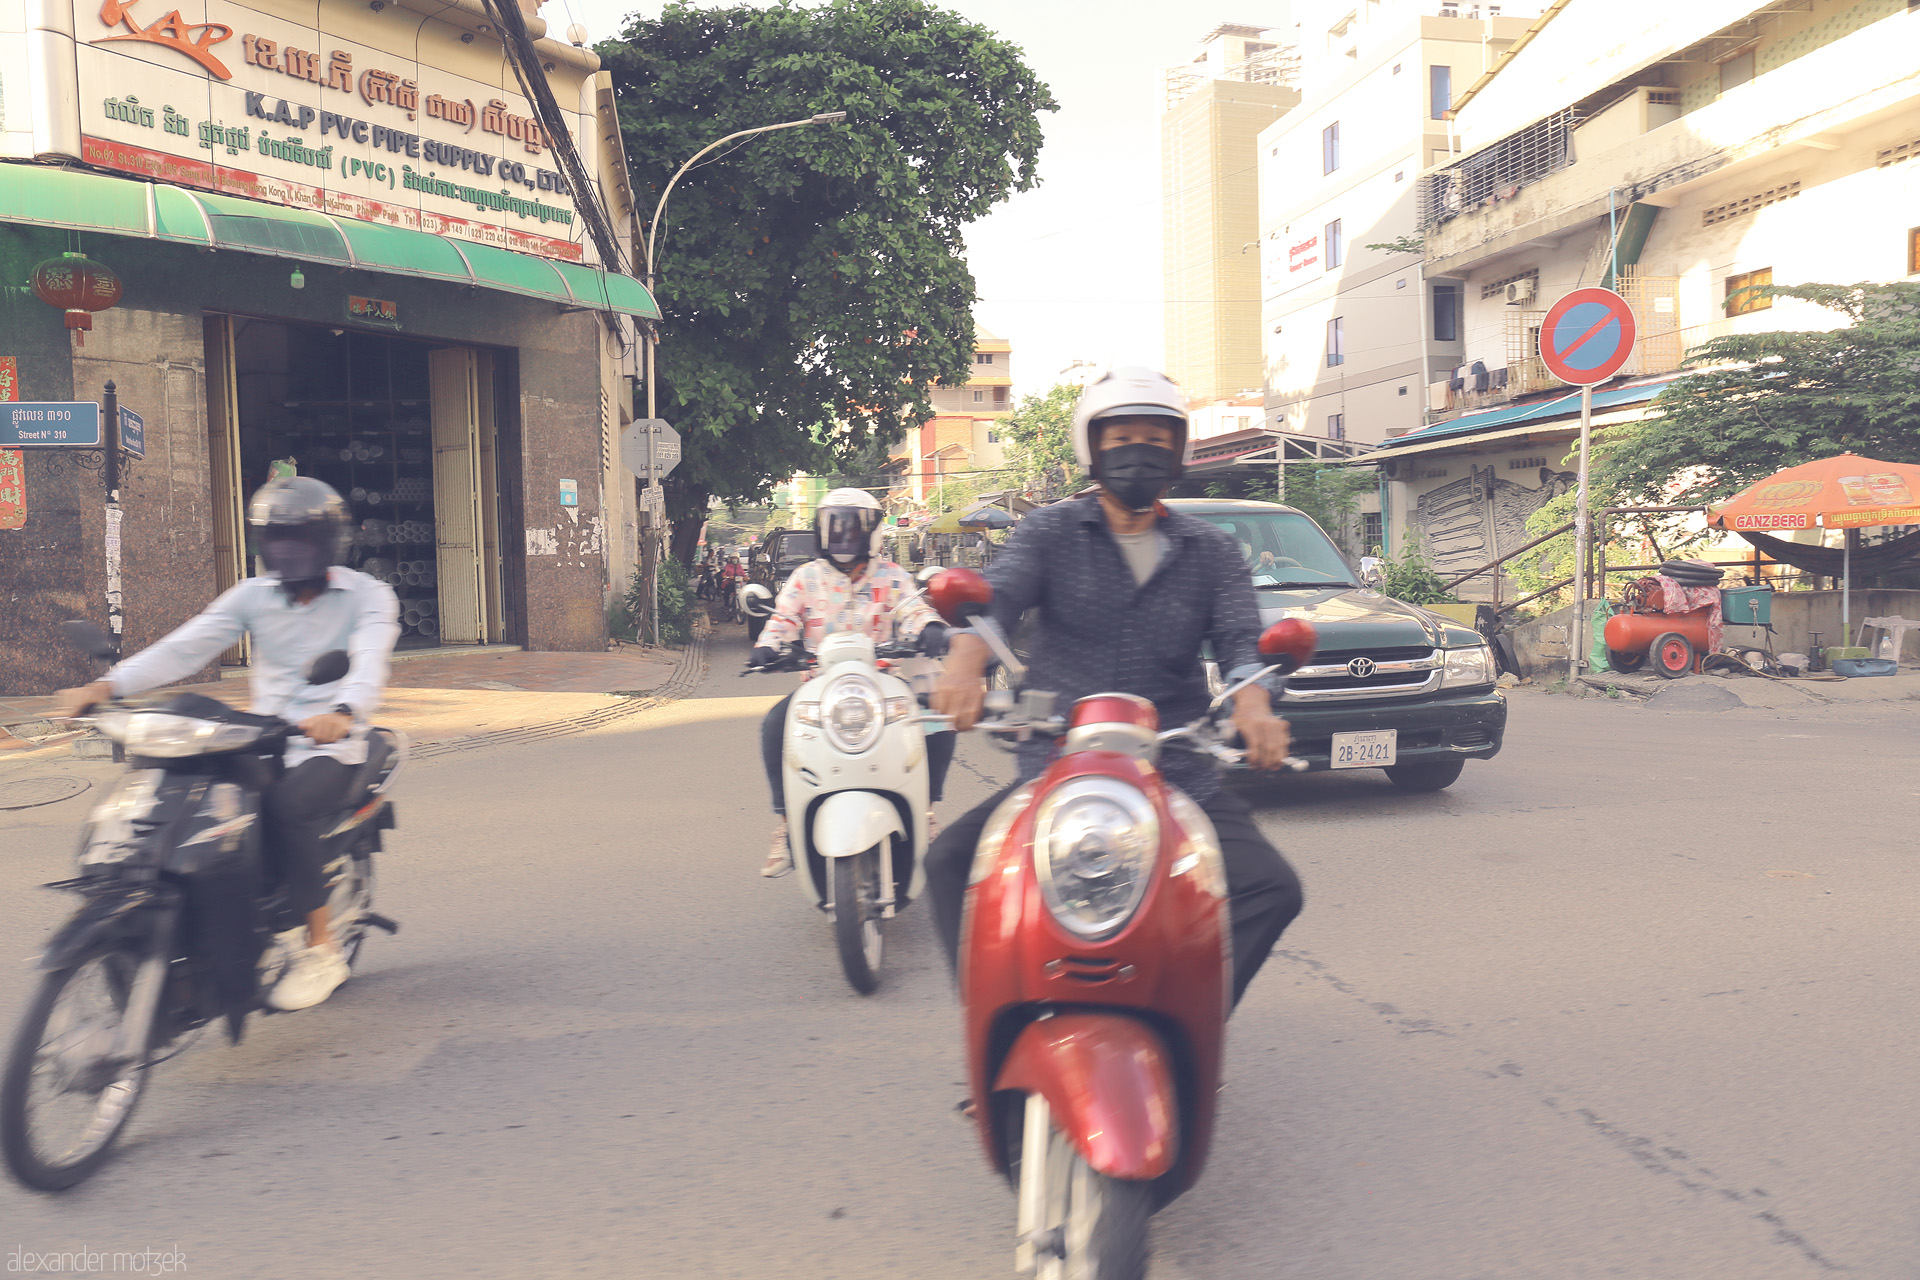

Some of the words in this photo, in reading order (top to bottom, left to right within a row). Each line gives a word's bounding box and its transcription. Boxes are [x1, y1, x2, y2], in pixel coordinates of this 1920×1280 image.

[104, 94, 154, 128] ផលិត
[163, 104, 189, 137] និង
[341, 155, 395, 190] (PVC)
[245, 91, 316, 130] K.A.P
[320, 110, 369, 144] PVC
[372, 125, 420, 158] PIPE
[423, 138, 496, 176] SUPPLY
[118, 152, 142, 168] St.310
[268, 184, 286, 201] Kong
[47, 409, 71, 421] ៣១០
[18, 430, 40, 439] Street
[54, 430, 67, 440] 310
[1736, 513, 1807, 529] GANZBERG
[1339, 744, 1389, 762] 2B-2421
